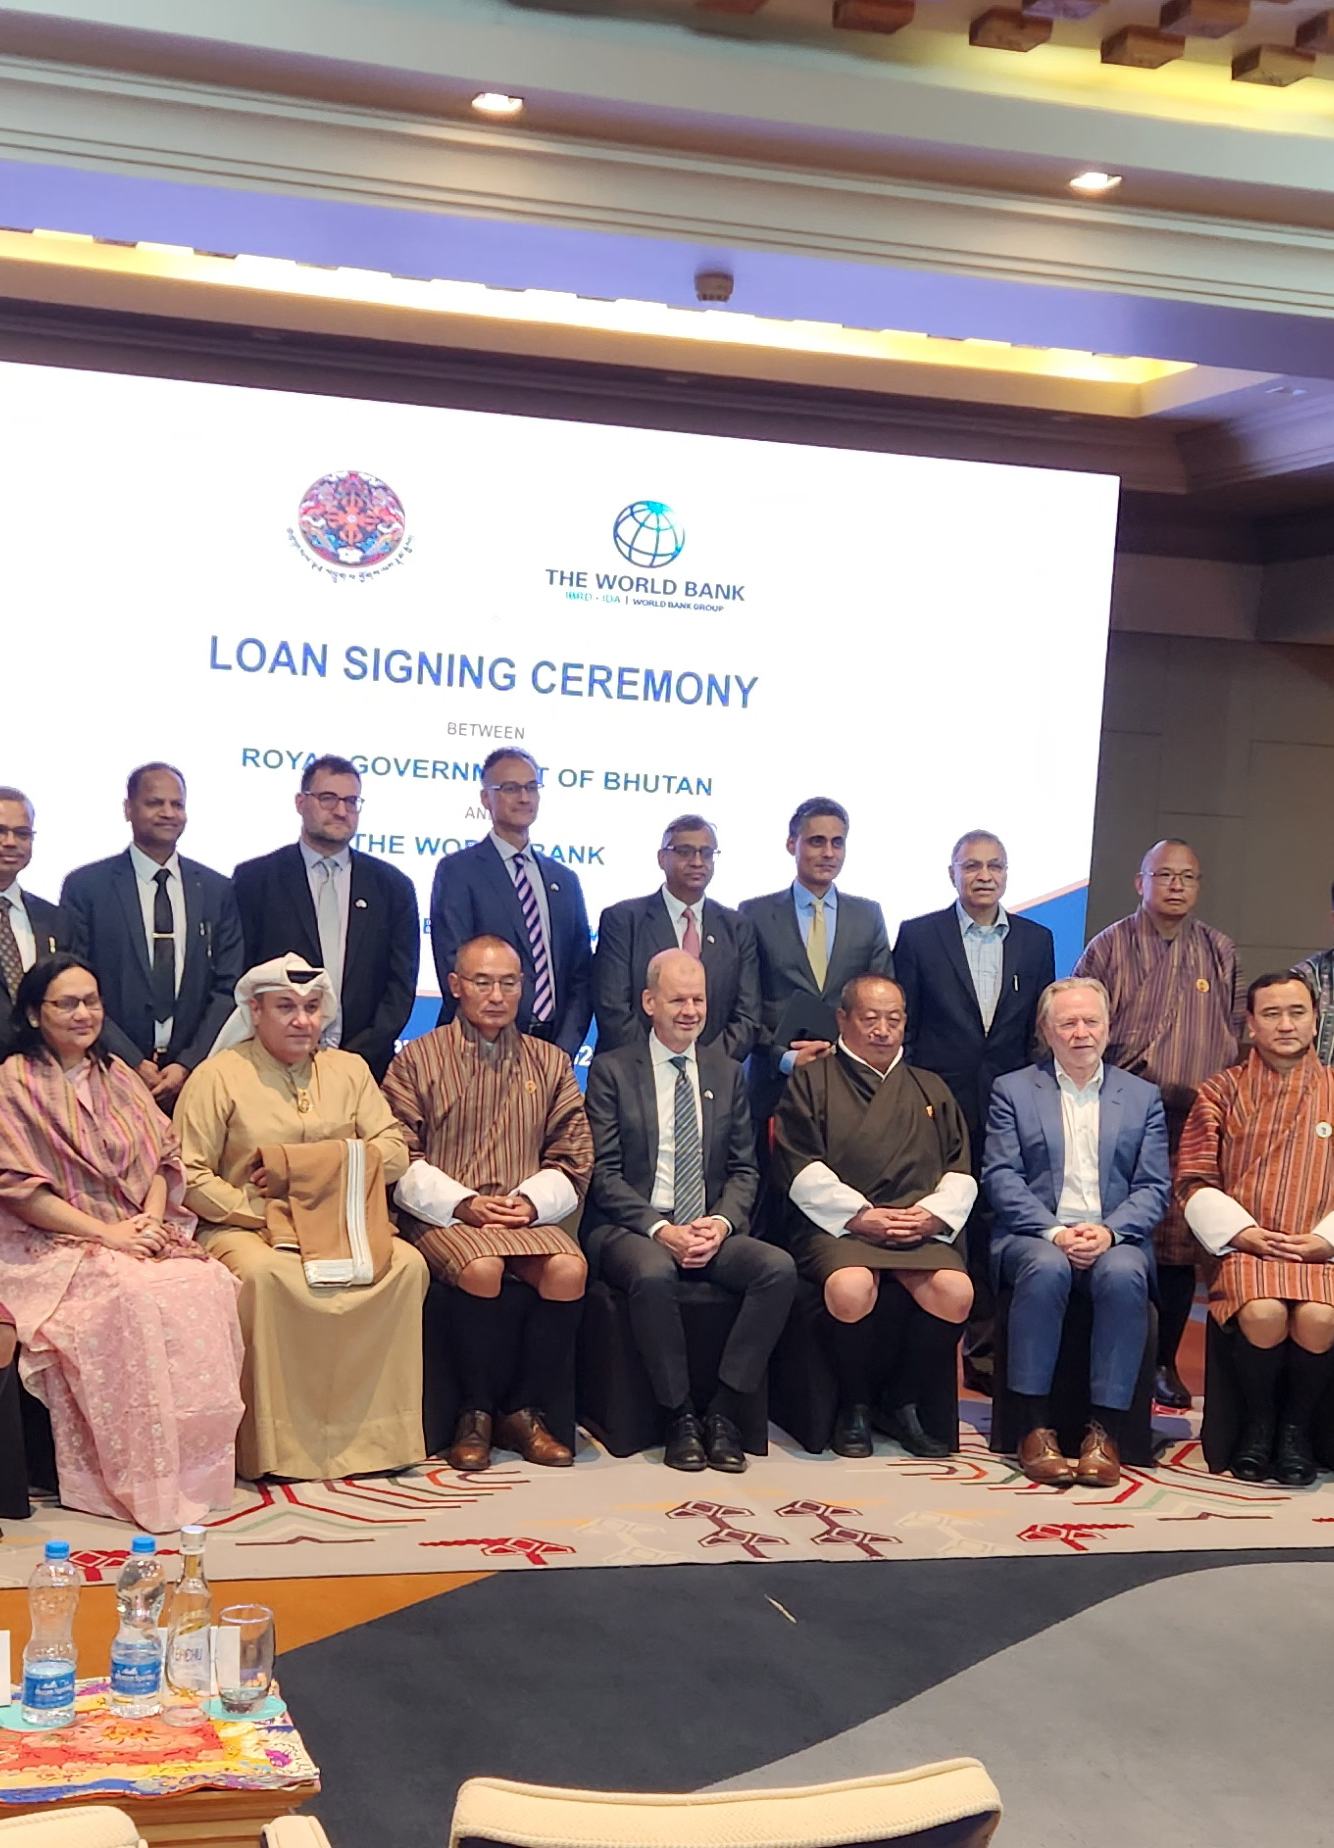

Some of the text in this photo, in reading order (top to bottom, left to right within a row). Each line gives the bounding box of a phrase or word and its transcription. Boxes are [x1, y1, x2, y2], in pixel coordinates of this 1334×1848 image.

[545, 568, 746, 602] THE WORLD BANK
[633, 598, 667, 608] WORLD
[668, 601, 692, 610] BANK
[693, 603, 725, 613] GROUP
[210, 634, 759, 709] LOAN SIGNING CEREMONY
[447, 721, 525, 740] BETWEEN
[557, 768, 595, 788] OF
[603, 771, 713, 796] BHUTAN
[464, 806, 492, 820] AN
[354, 833, 405, 854] THE
